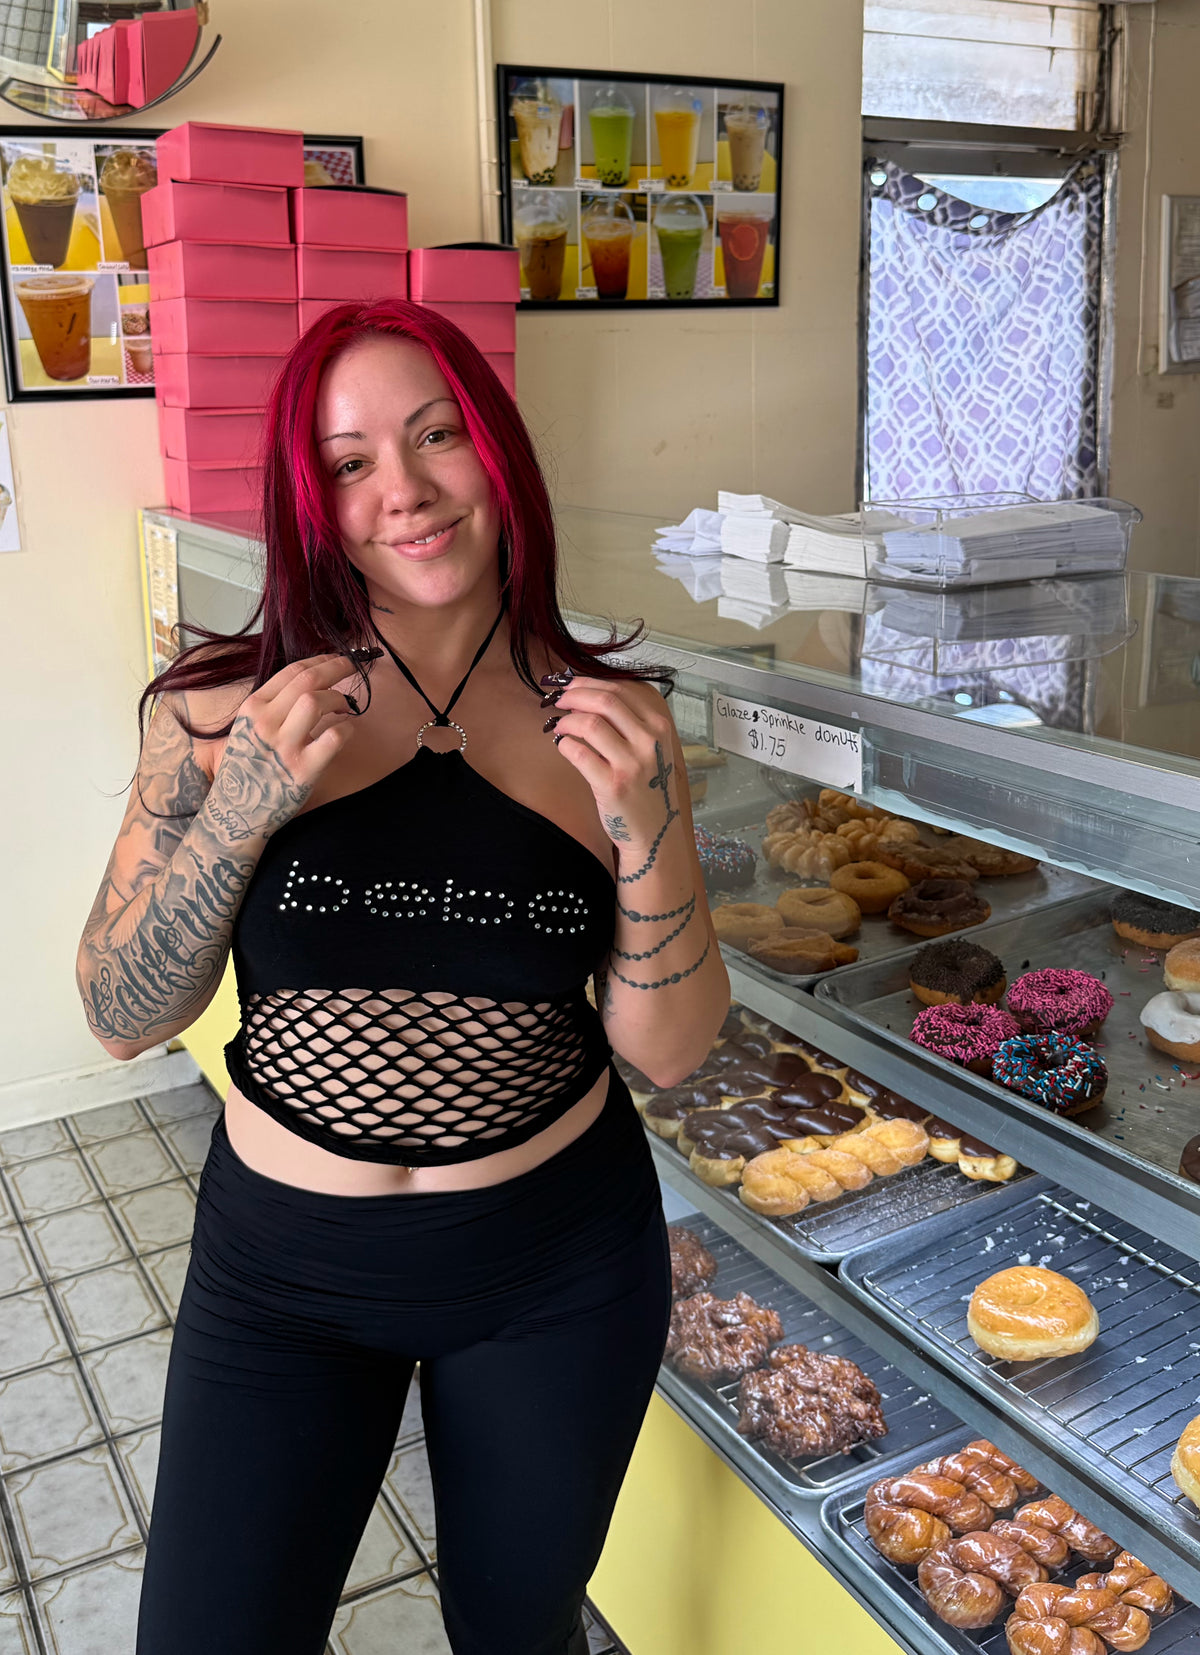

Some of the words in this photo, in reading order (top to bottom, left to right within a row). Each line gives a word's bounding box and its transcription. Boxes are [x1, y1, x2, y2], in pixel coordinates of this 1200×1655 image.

[716, 698, 751, 721] Glaze
[762, 709, 806, 735] Sprinkle
[747, 728, 786, 757] $1.75
[279, 860, 589, 934] bebe
[86, 852, 254, 1040] California
